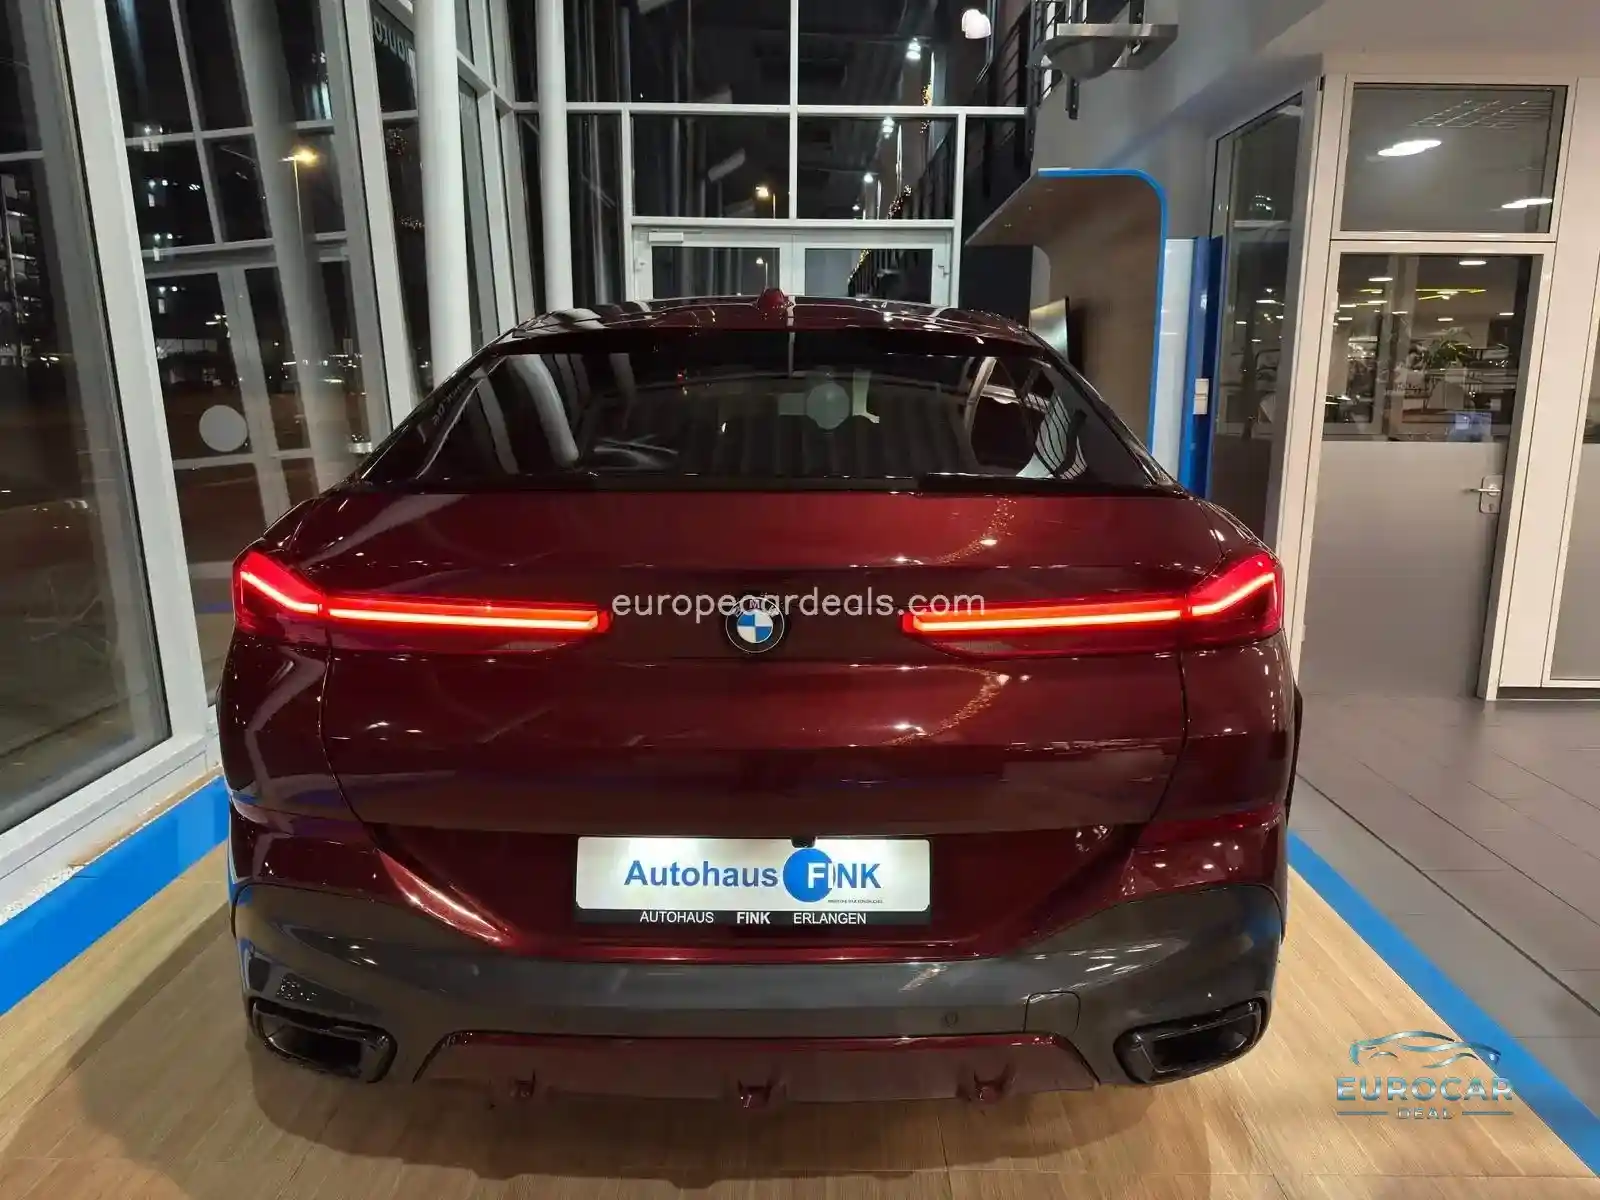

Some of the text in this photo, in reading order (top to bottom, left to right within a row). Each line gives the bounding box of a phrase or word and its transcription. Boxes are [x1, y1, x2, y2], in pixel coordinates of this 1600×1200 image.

[623, 860, 882, 889] Autohaus FINK
[639, 911, 867, 925] AUTOHAUS FINK ERLANGEN
